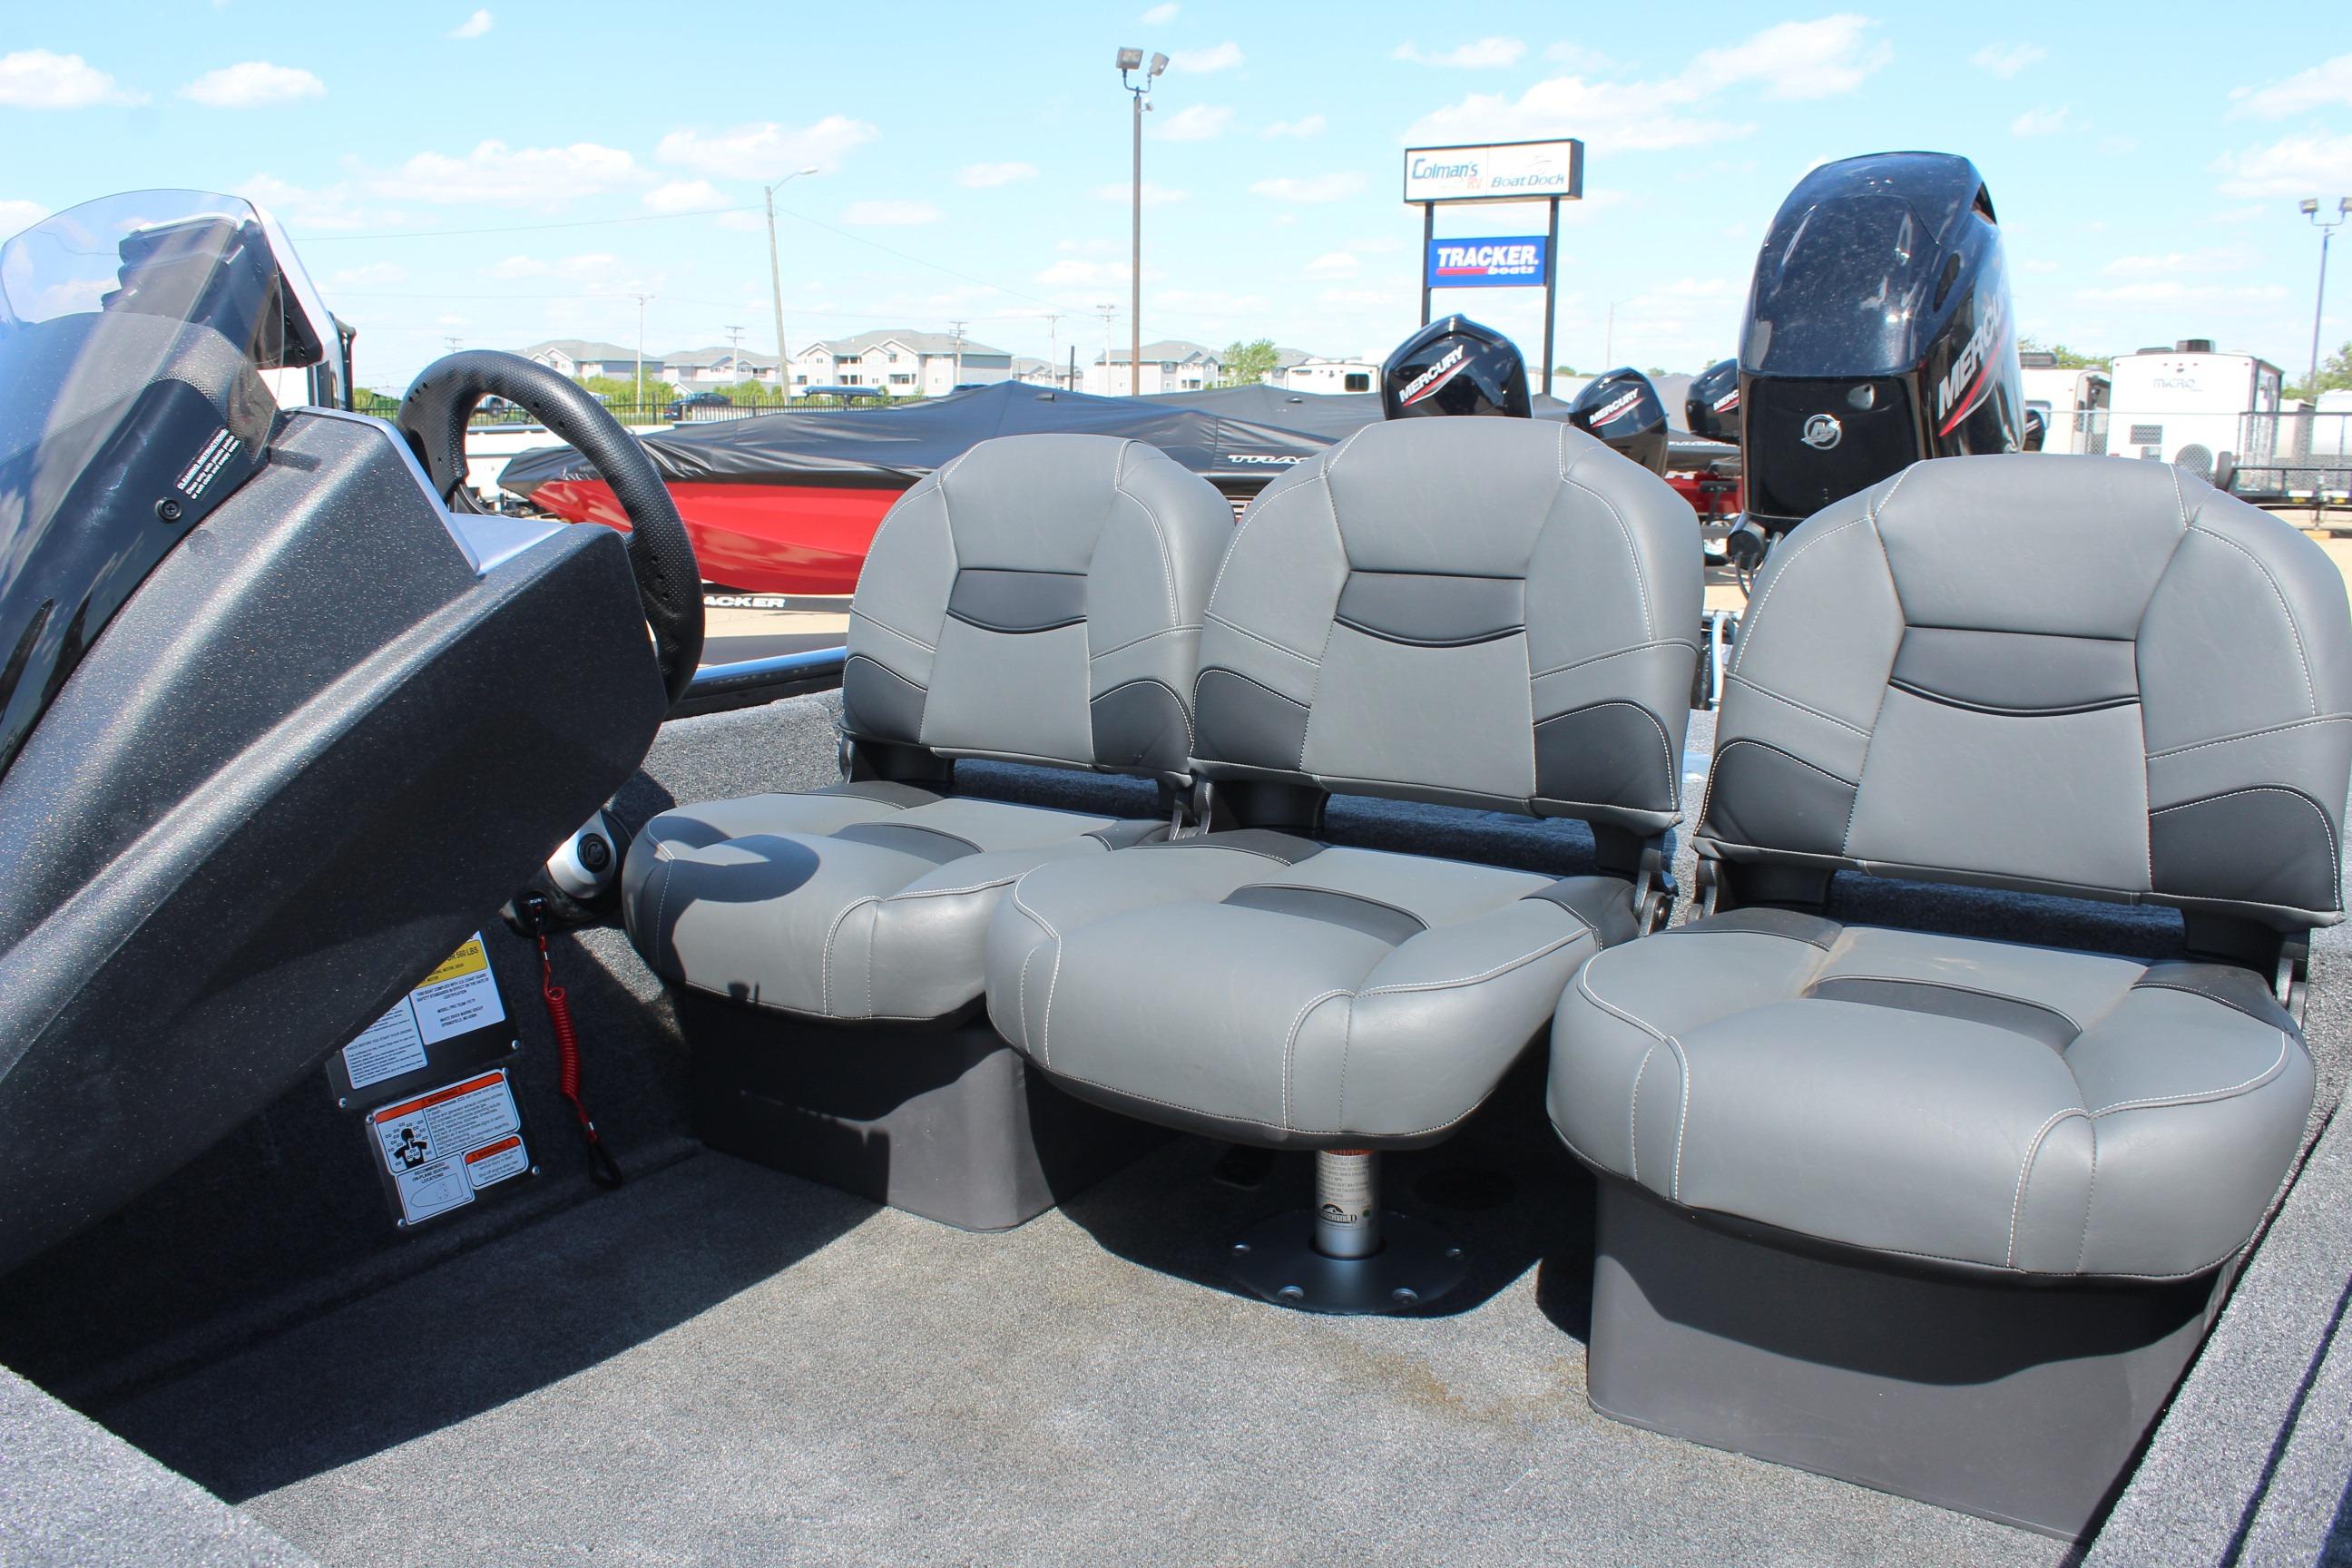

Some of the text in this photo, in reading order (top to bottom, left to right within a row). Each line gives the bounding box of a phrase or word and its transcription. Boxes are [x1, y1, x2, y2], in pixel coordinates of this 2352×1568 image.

[1412, 157, 1478, 180] Colman's
[1491, 174, 1565, 188] Boat Dock
[1487, 266, 1535, 275] boats
[1399, 345, 1464, 402] MERCURY
[1590, 388, 1639, 425] MERCURY
[177, 464, 201, 490] CLEANING
[186, 481, 198, 495] Clean
[196, 471, 206, 483] only
[203, 462, 213, 473] with
[704, 596, 785, 607] ACKER
